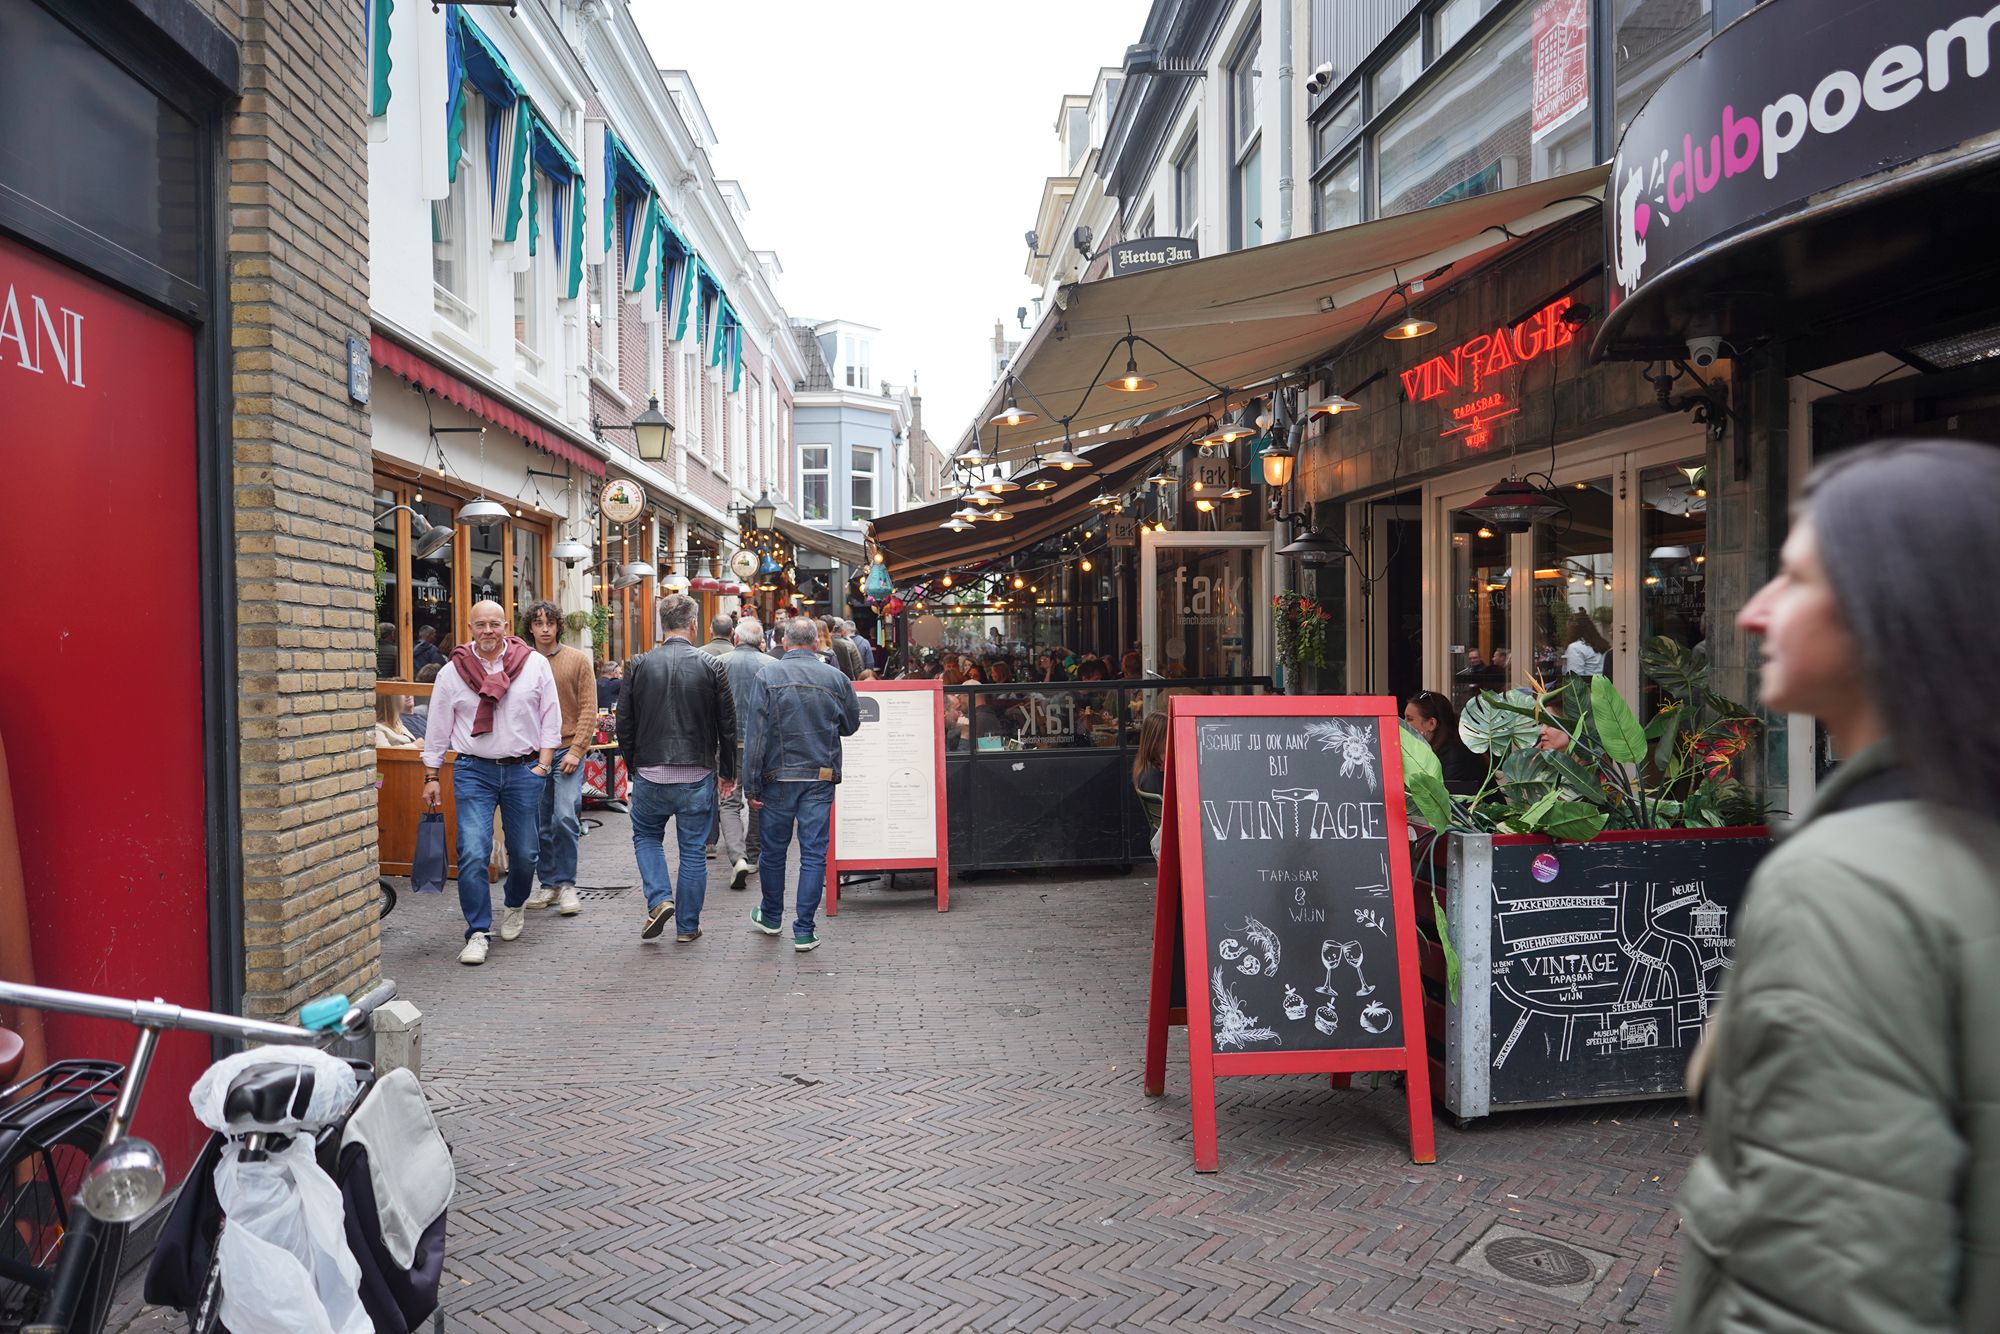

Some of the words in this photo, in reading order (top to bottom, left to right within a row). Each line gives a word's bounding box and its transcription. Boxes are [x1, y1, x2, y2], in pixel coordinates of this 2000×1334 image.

[1119, 249, 1165, 268] Hertog
[1166, 247, 1193, 265] Jan
[1399, 296, 1573, 401] VINTAGE
[1452, 393, 1504, 420] TAPASBAR
[1472, 415, 1482, 431] &
[1205, 733, 1243, 751] SCHUIF
[1247, 734, 1262, 751] JIJ
[1266, 734, 1283, 750] OOK
[1285, 733, 1311, 751] AAN?
[1269, 756, 1289, 777] BIJ
[1202, 787, 1387, 841] VINTAGE
[1257, 868, 1319, 883] TAPASBAR
[1672, 882, 1698, 896] NEUDE
[1510, 897, 1606, 912] ZAKKENDRAGERSTEEG
[1289, 907, 1326, 924] WIJN
[1512, 932, 1603, 952] DRIEHARINGENSTRAAT
[1703, 938, 1736, 948] STADHUIS
[1499, 959, 1515, 968] BENT
[1623, 943, 1667, 969] OUDEGRACHT
[1495, 967, 1511, 975] HIER
[1520, 953, 1619, 977] VINTAGE
[1548, 972, 1594, 985] TAPASBAR
[1570, 983, 1578, 993] &
[1559, 991, 1584, 1002] WIJN
[1612, 1000, 1654, 1013] STEENWEG
[1593, 1029, 1620, 1038] MUSEUM
[1585, 1037, 1619, 1047] SPEELKLOK
